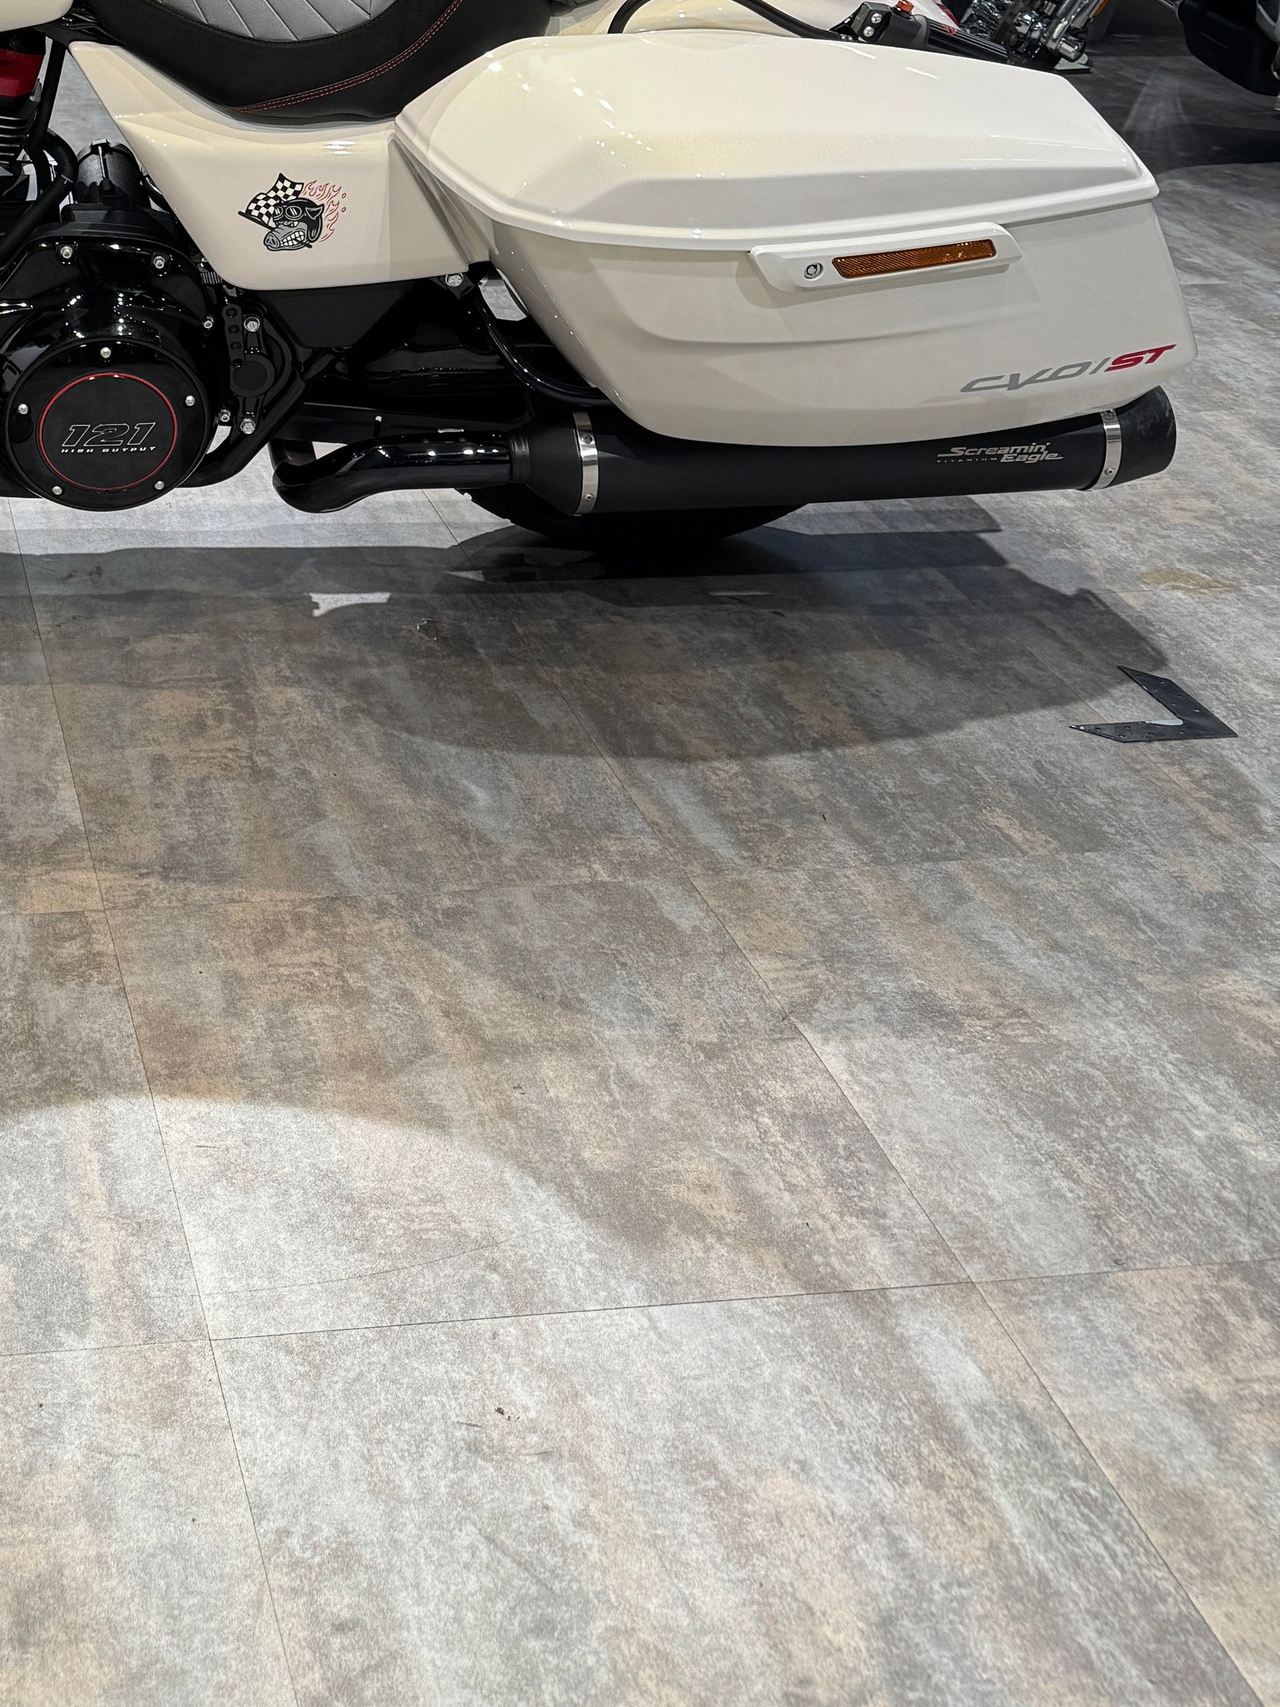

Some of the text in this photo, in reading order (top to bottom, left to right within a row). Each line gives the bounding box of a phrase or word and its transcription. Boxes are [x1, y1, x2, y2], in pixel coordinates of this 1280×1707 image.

[61, 421, 156, 447] 121
[101, 446, 156, 454] OUTPUT
[1000, 451, 1063, 464] Eagle
